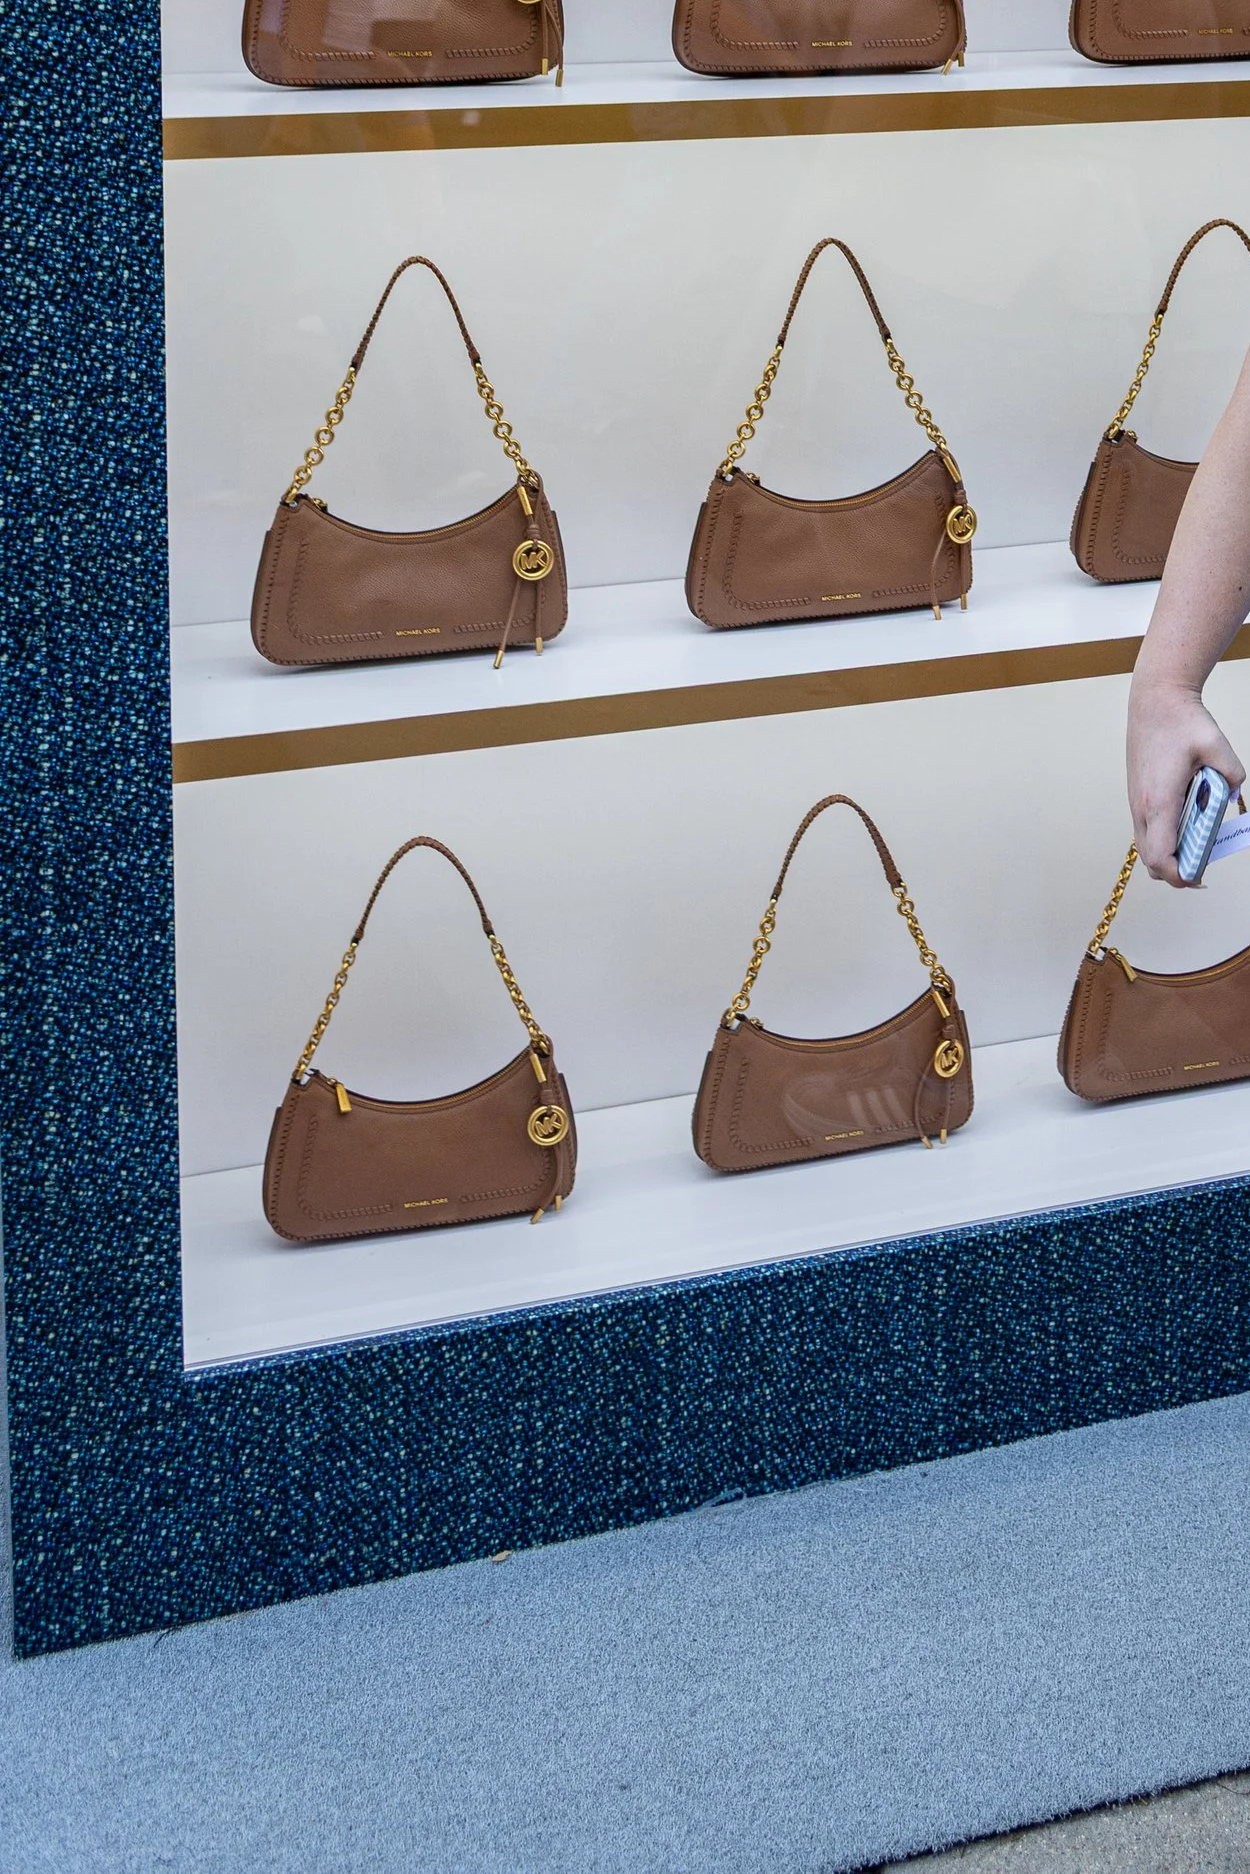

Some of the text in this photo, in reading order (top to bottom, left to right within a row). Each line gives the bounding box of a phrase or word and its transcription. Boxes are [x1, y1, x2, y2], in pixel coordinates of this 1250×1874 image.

[387, 50, 414, 58] MICHAEL
[952, 513, 973, 534] MK
[520, 550, 546, 571] MK
[941, 1046, 958, 1069] MK
[535, 1113, 563, 1137] MK
[824, 1133, 848, 1141] MICHAEL
[404, 1200, 431, 1208] MICHAEL
